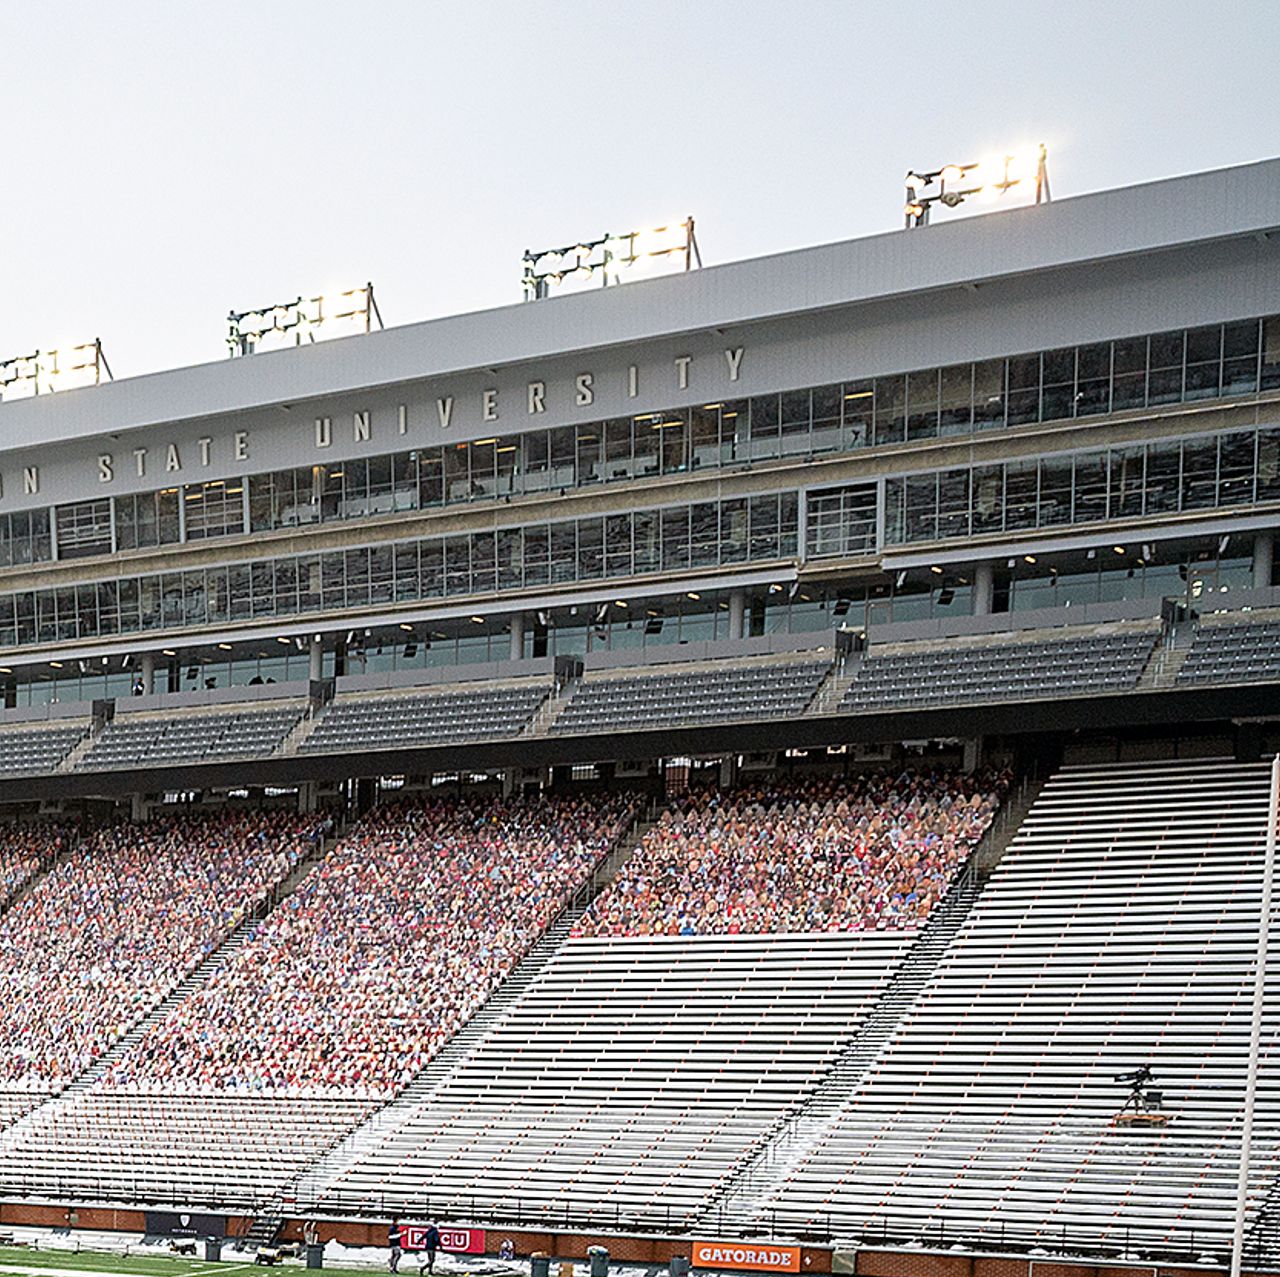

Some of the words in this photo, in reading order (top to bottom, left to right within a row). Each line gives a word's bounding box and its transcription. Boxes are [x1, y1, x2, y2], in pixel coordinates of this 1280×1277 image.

[98, 431, 249, 483] STATE
[314, 348, 744, 449] UNIVERSITY
[699, 1247, 793, 1266] GATORADE
